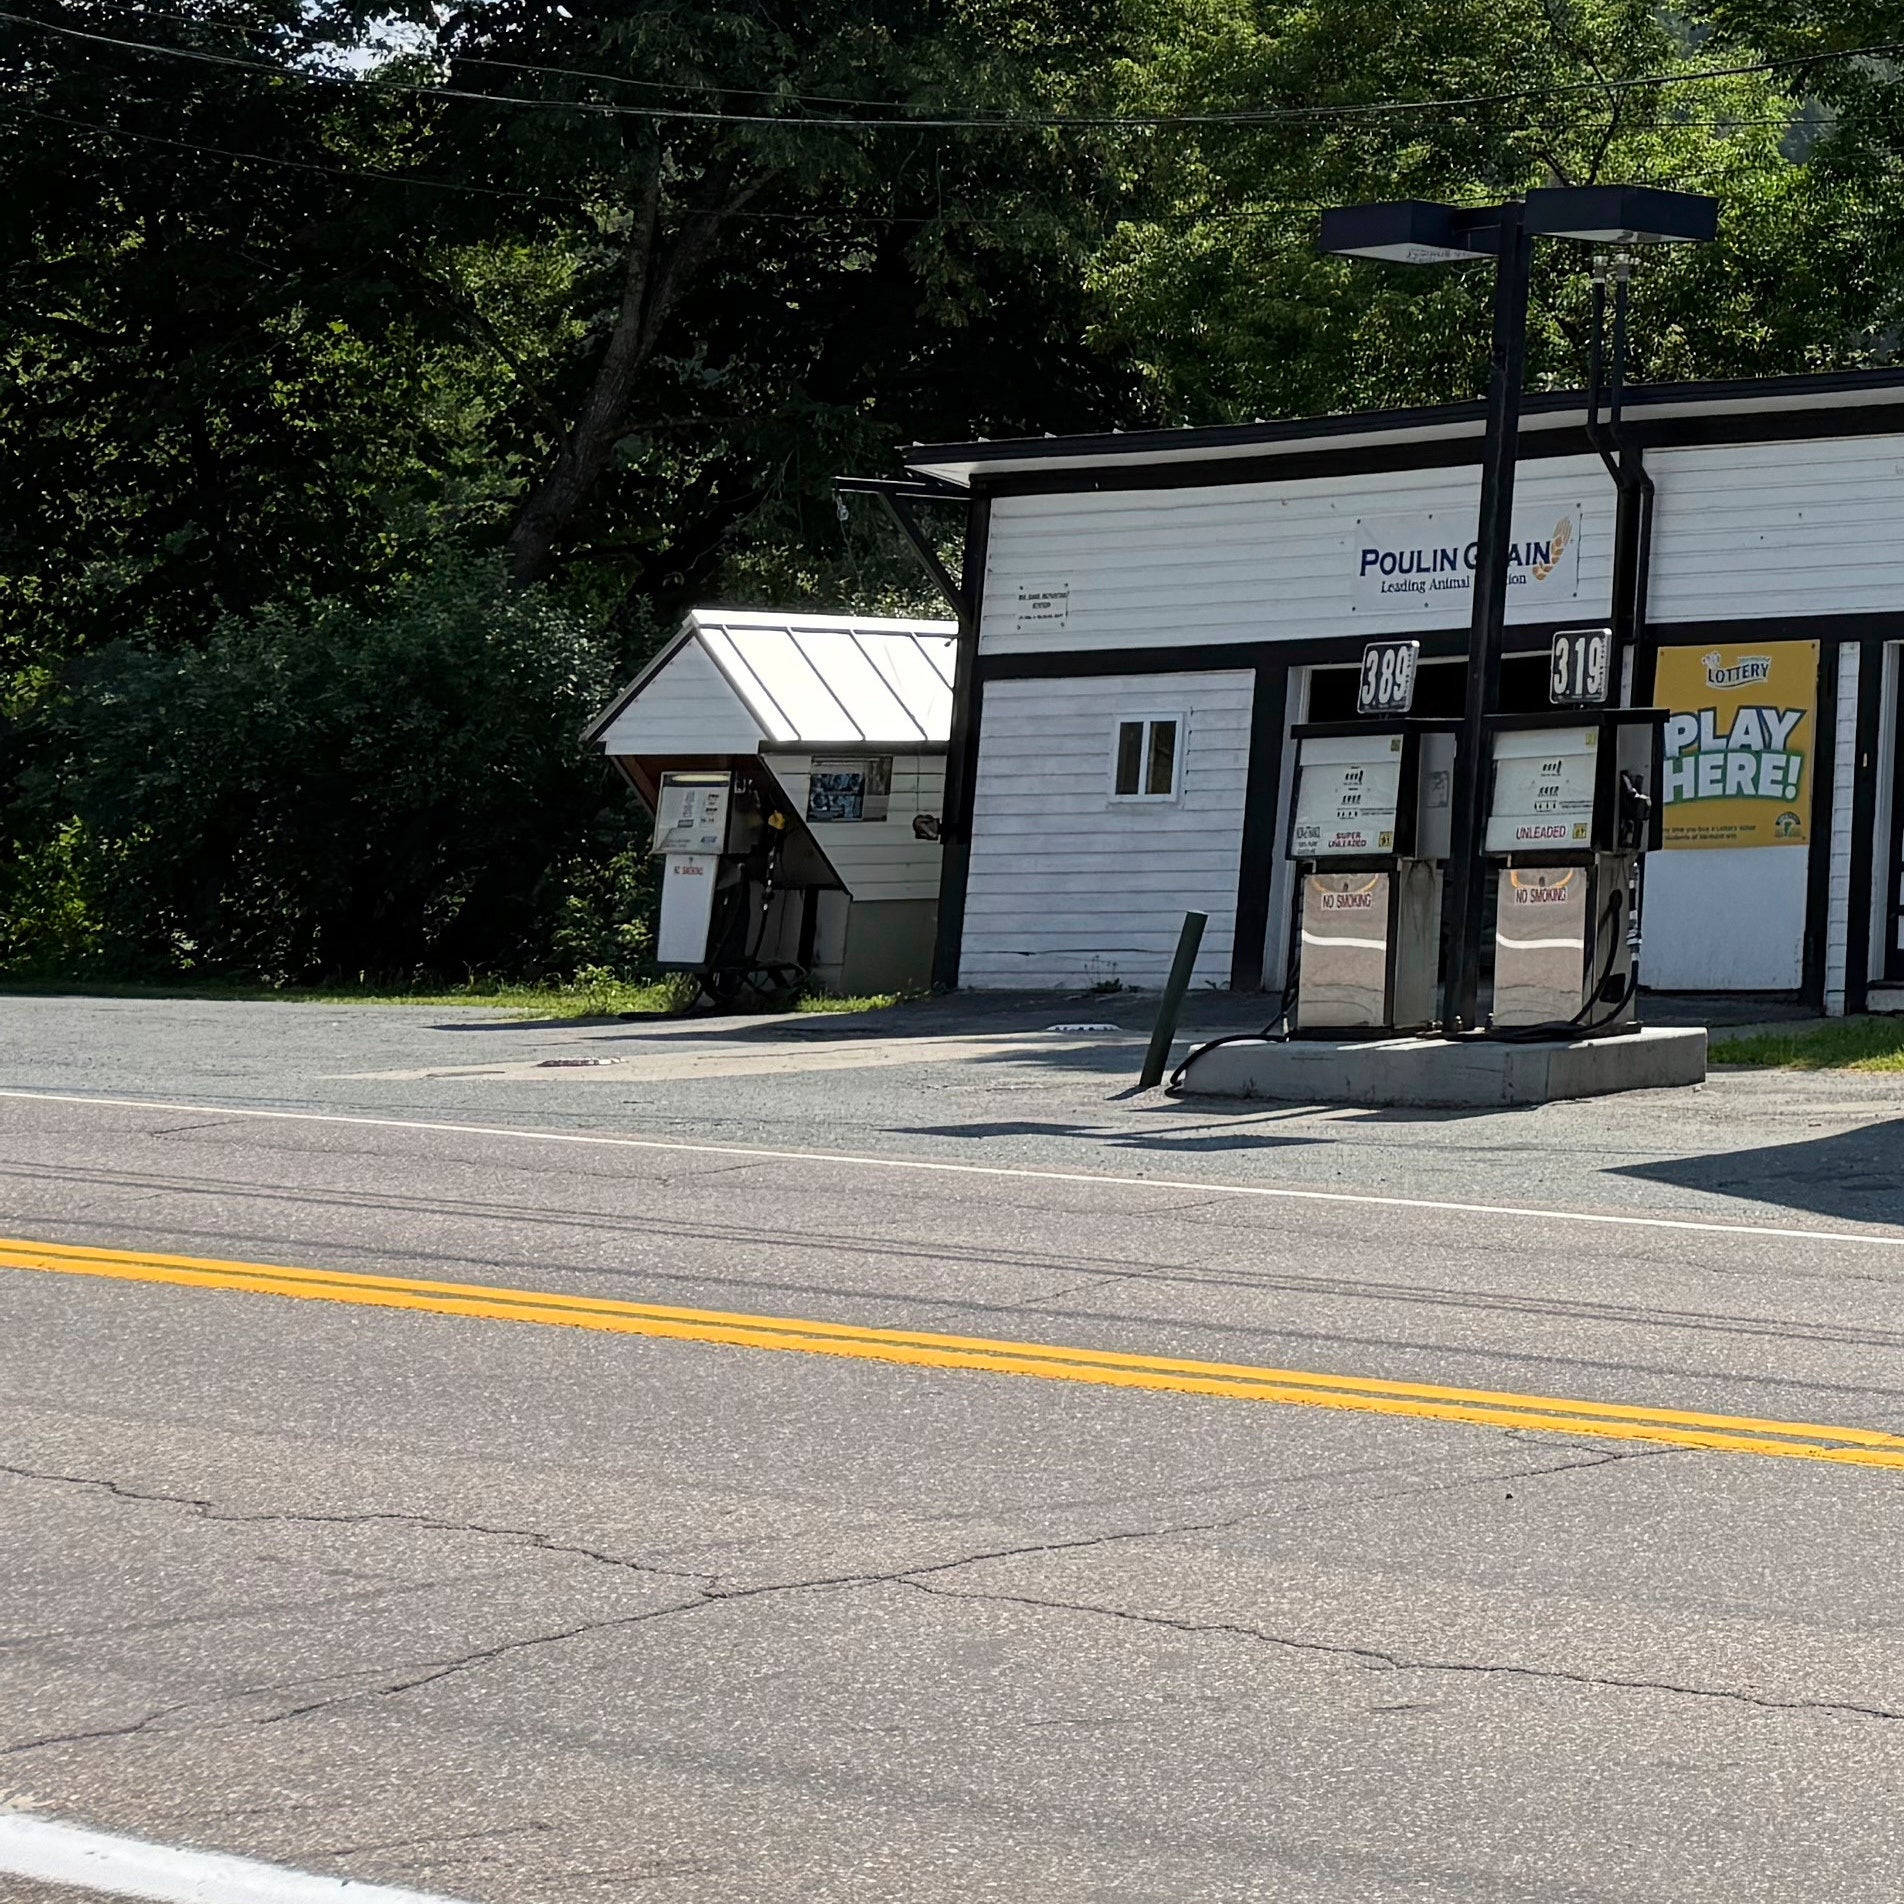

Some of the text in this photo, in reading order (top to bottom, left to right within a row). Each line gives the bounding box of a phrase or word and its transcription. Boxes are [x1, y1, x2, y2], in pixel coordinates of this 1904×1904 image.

[1359, 540, 1552, 577] POULIN GAIN
[1380, 576, 1470, 594] Leading Animal
[1553, 636, 1602, 695] 3.19
[1708, 663, 1769, 684] LOTTERY
[1664, 706, 1807, 758] PLAY
[1663, 752, 1803, 804] HERE!
[1335, 832, 1362, 840] SUPER
[1515, 826, 1567, 841] UNLEADED
[1322, 893, 1372, 908] NO SMOKING
[1515, 887, 1567, 904] NO SMOKING
